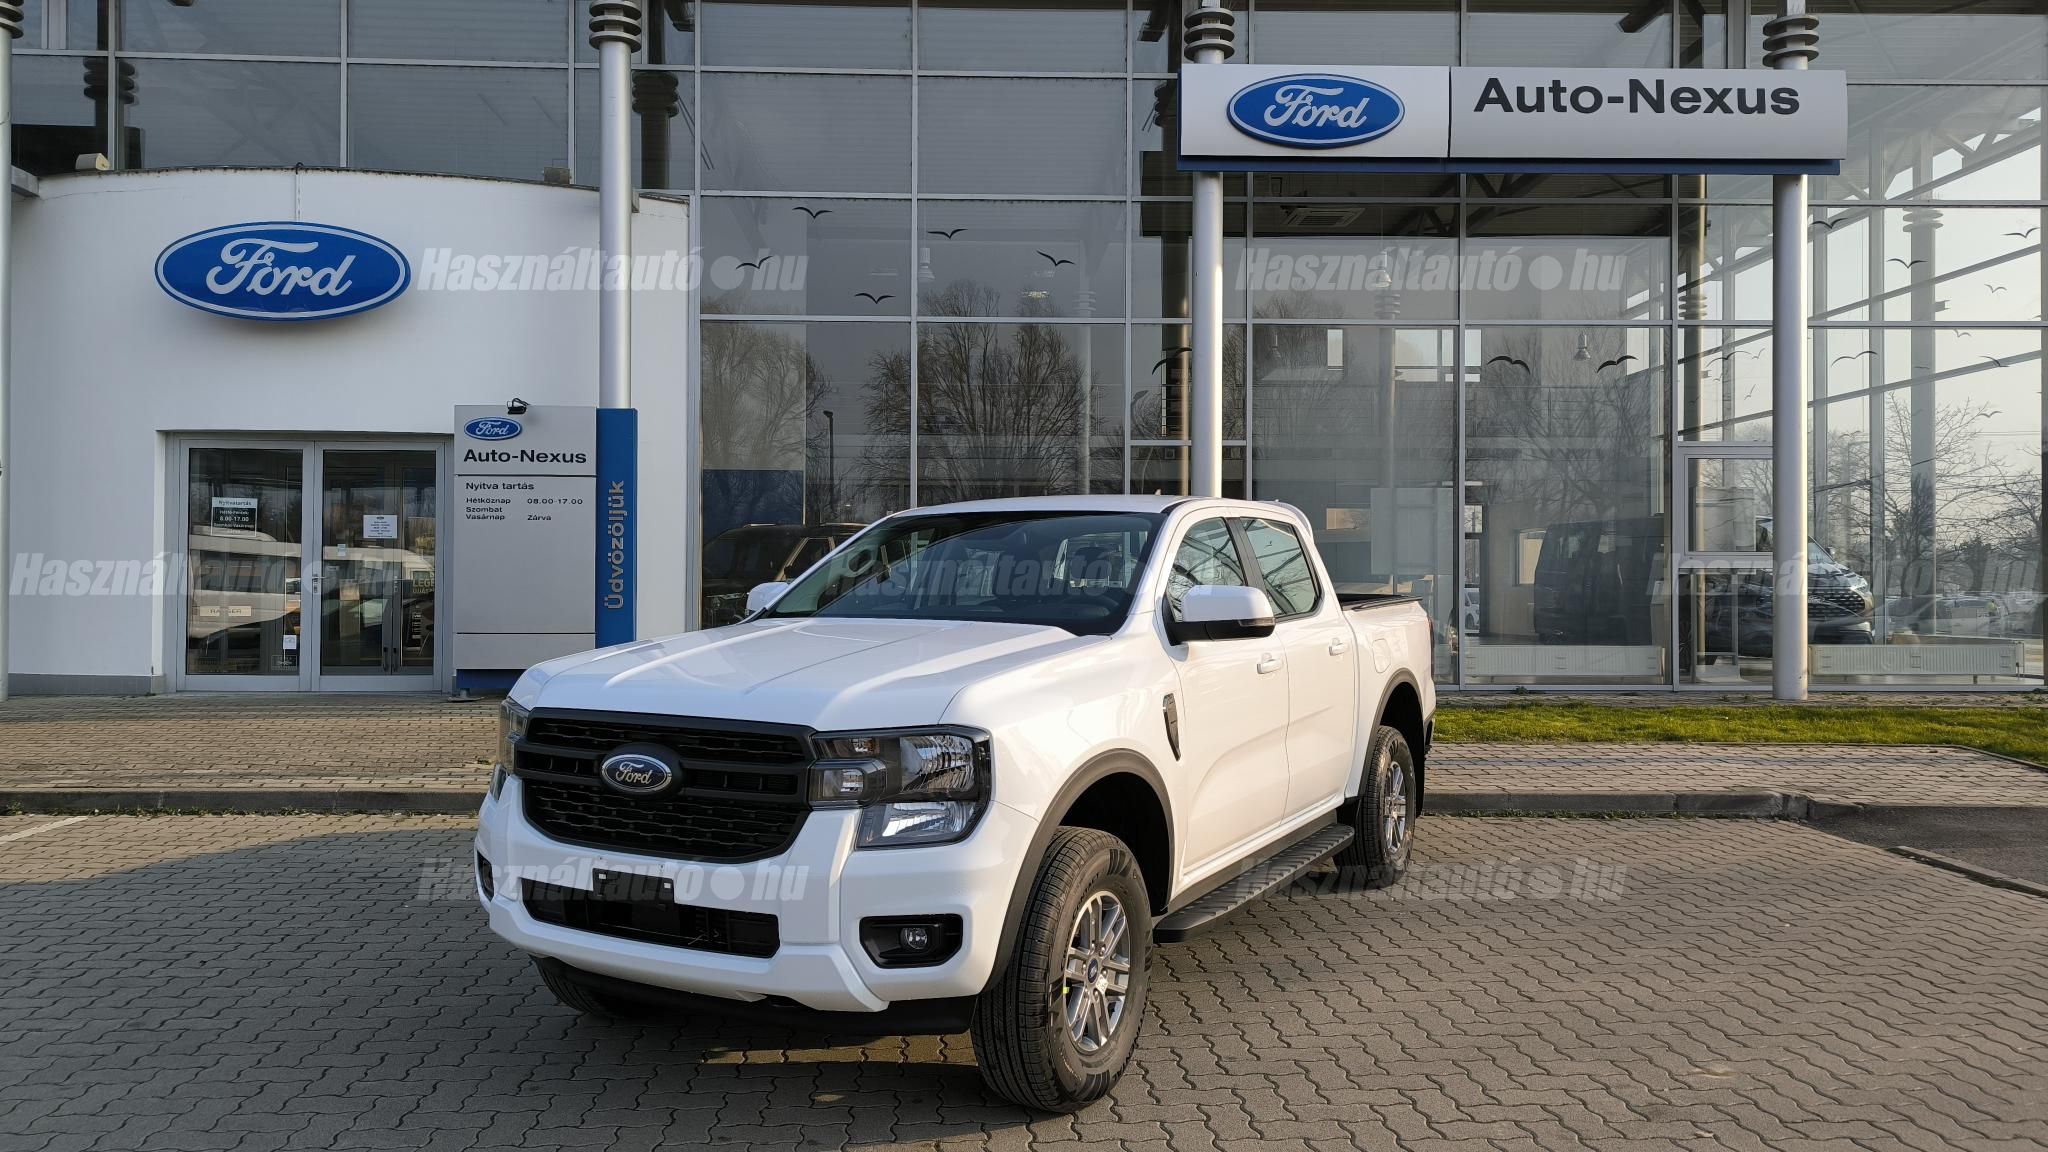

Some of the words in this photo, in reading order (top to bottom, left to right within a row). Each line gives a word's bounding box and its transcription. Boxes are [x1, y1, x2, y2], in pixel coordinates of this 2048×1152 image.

[1263, 84, 1370, 128] Ford
[1473, 77, 1800, 115] Auto-Nexus
[205, 238, 356, 297] Ford
[475, 420, 509, 436] Ford
[463, 449, 587, 463] Auto-Nexus
[466, 483, 499, 491] Nyitva
[502, 482, 535, 490] tartás
[604, 480, 627, 609] Üdvözöljük
[615, 761, 653, 784] Ford
